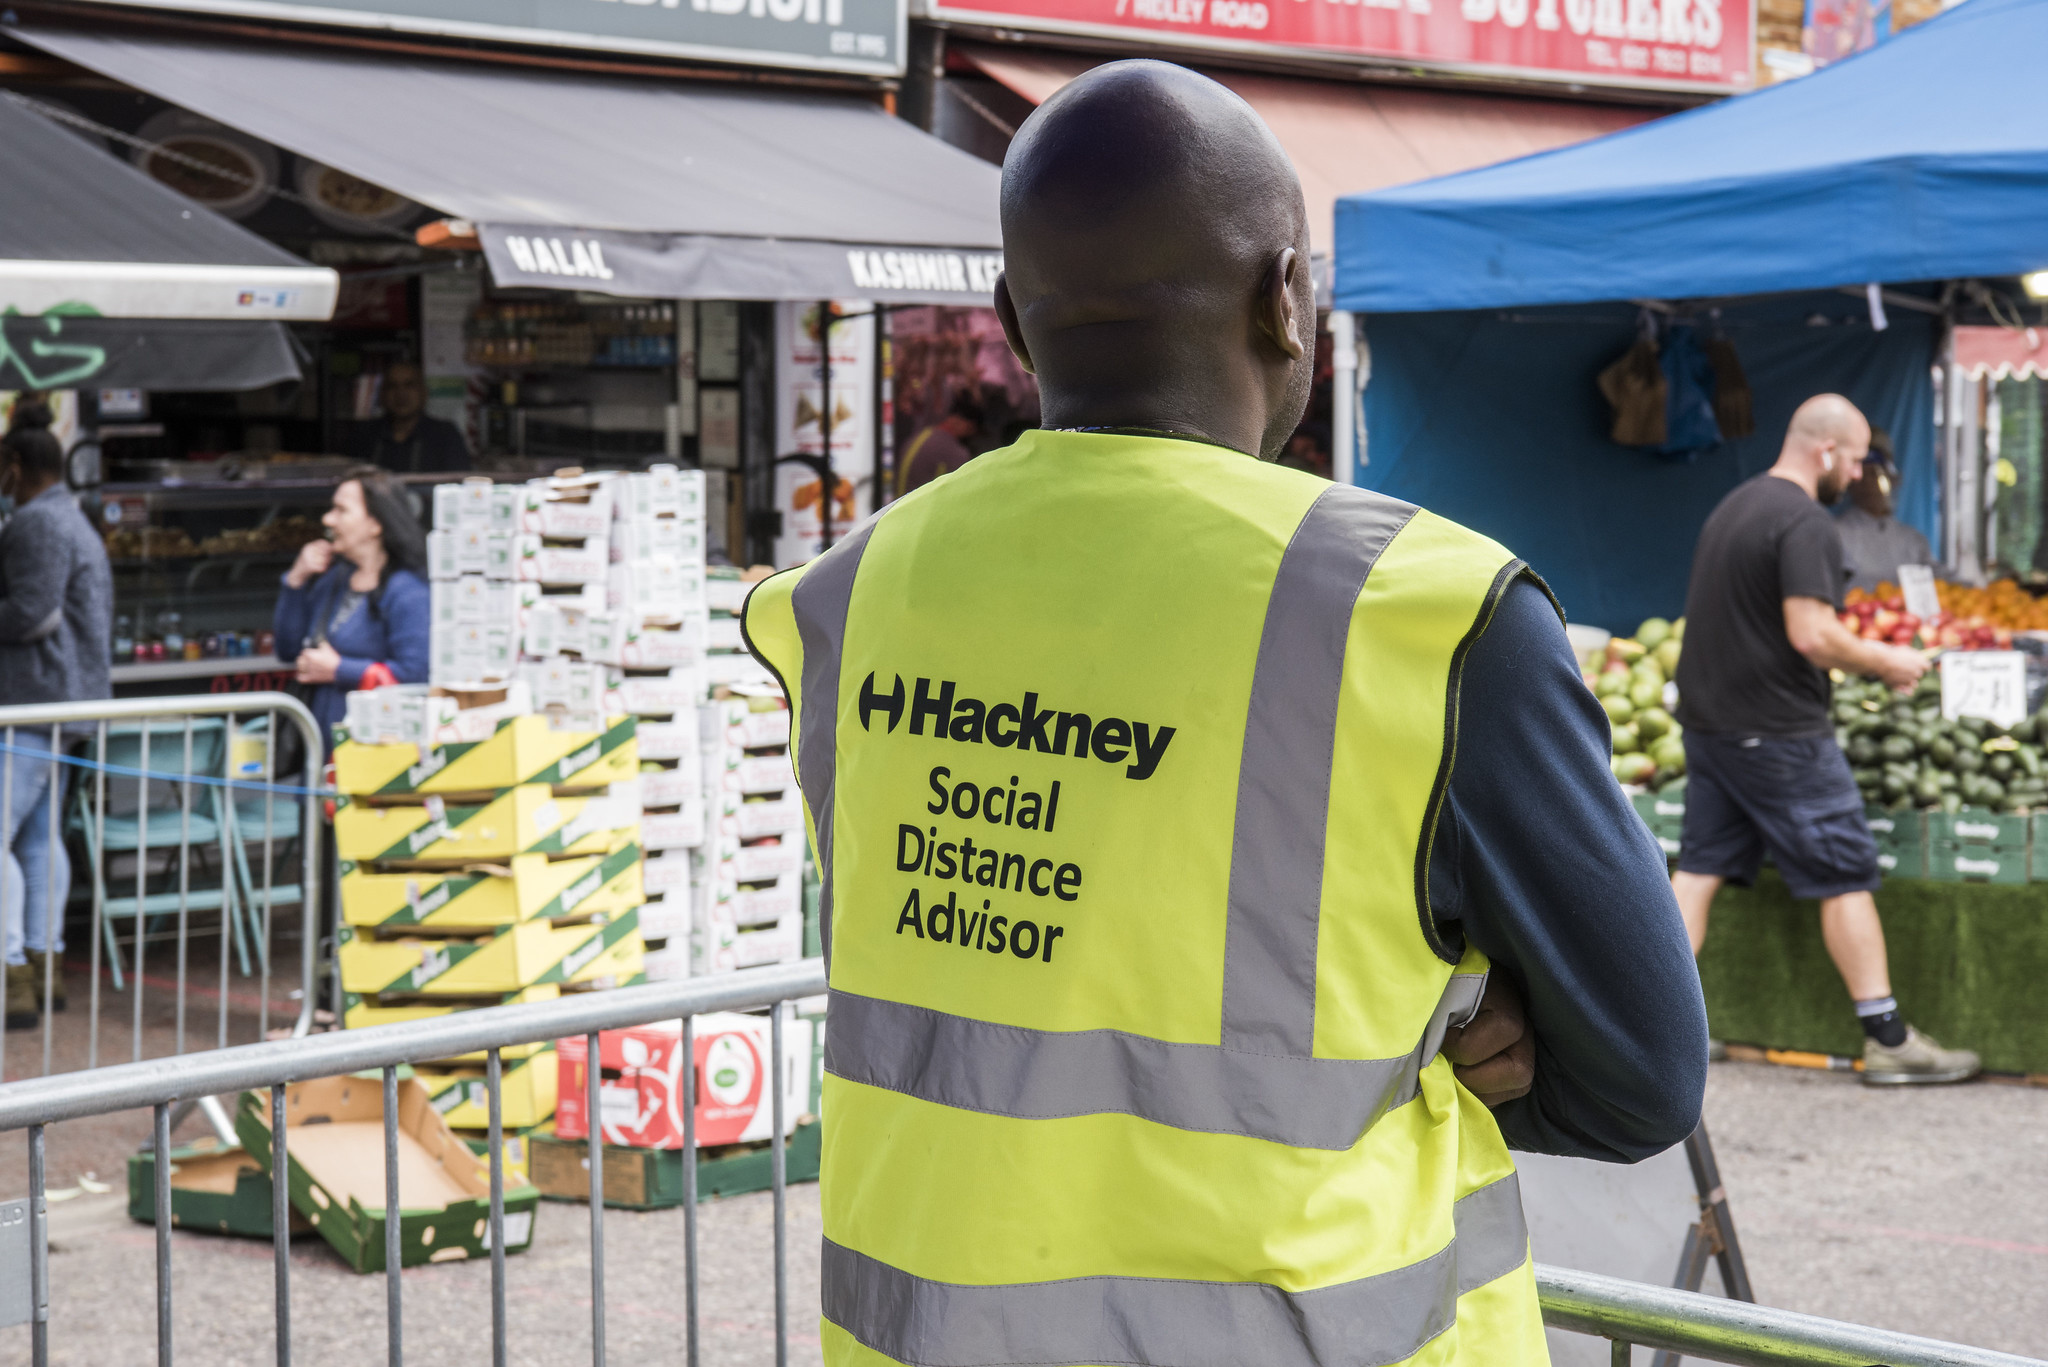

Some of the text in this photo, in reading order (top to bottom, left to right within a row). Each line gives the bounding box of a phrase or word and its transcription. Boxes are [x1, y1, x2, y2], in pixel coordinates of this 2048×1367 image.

[1463, 0, 1724, 48] CHERS
[506, 236, 1004, 293] HALAL KASHMIR KE
[909, 677, 1177, 780] Hackney
[927, 766, 1061, 832] Social
[896, 823, 1083, 902] Distance
[896, 888, 1064, 963] Advisor
